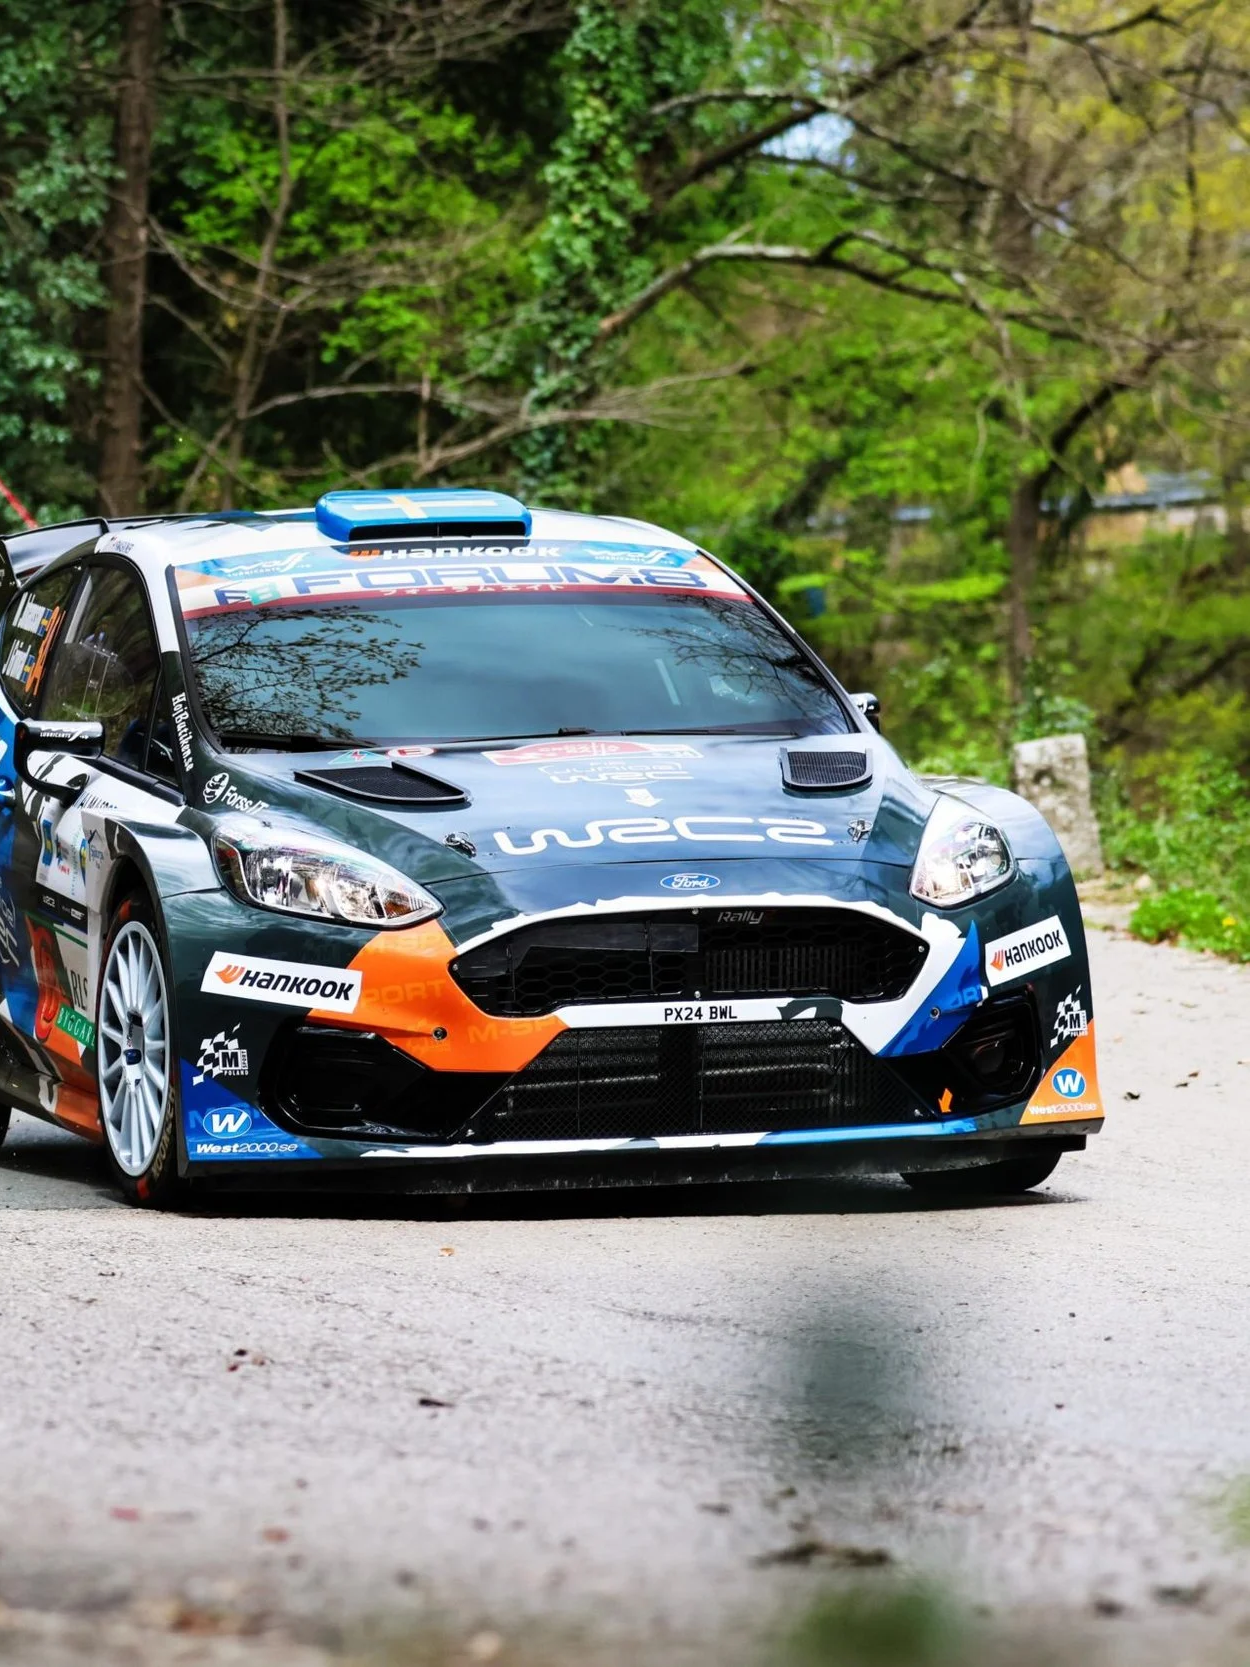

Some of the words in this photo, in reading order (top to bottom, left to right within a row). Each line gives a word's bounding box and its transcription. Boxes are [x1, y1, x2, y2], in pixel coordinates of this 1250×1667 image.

[291, 565, 708, 595] FORUM8
[221, 785, 252, 811] Forss
[671, 875, 710, 889] Ford
[664, 1007, 703, 1022] PX24
[709, 1005, 738, 1020] BWL
[1070, 1013, 1081, 1029] M
[221, 1052, 240, 1068] M
[1056, 1072, 1083, 1094] W
[212, 1111, 249, 1133] W
[196, 1141, 299, 1154] West2000.se
